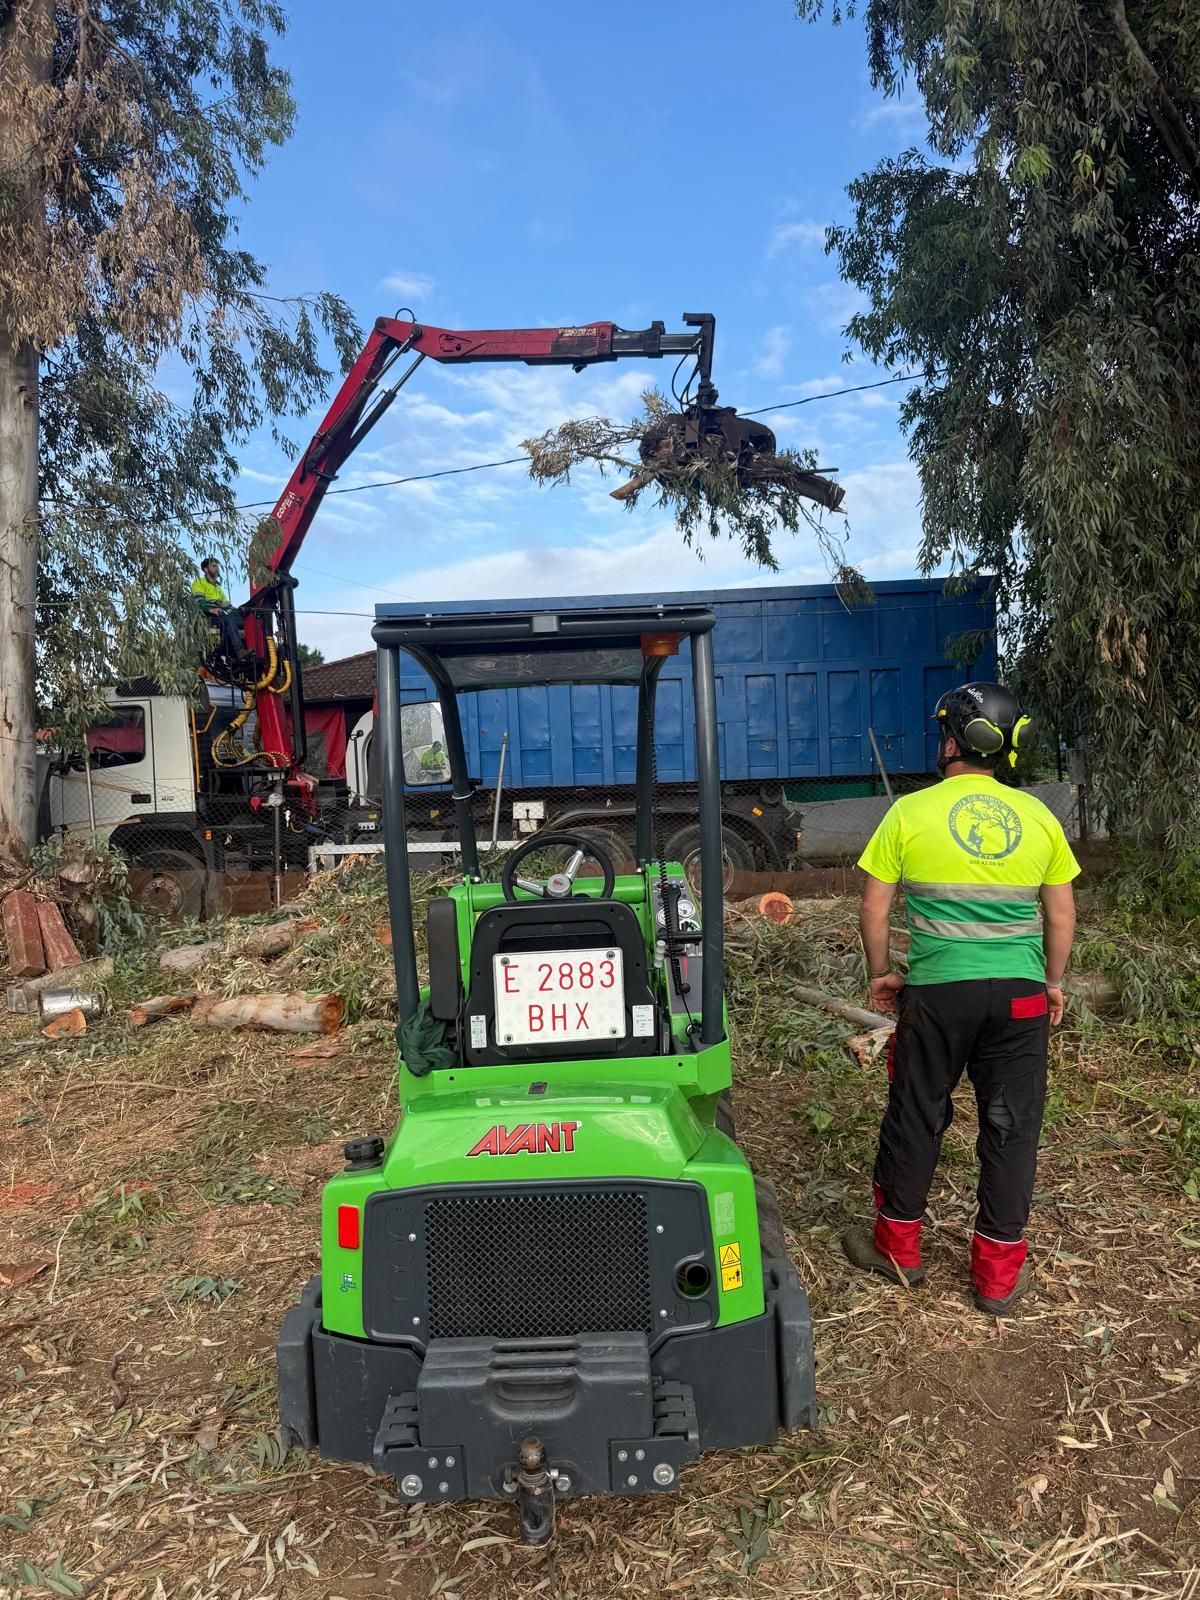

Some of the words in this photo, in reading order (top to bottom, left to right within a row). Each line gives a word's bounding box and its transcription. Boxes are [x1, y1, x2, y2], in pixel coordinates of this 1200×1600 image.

[504, 964, 520, 993] E
[538, 960, 615, 991] 2883
[528, 1002, 589, 1032] BHX
[465, 1121, 577, 1157] AVANT
